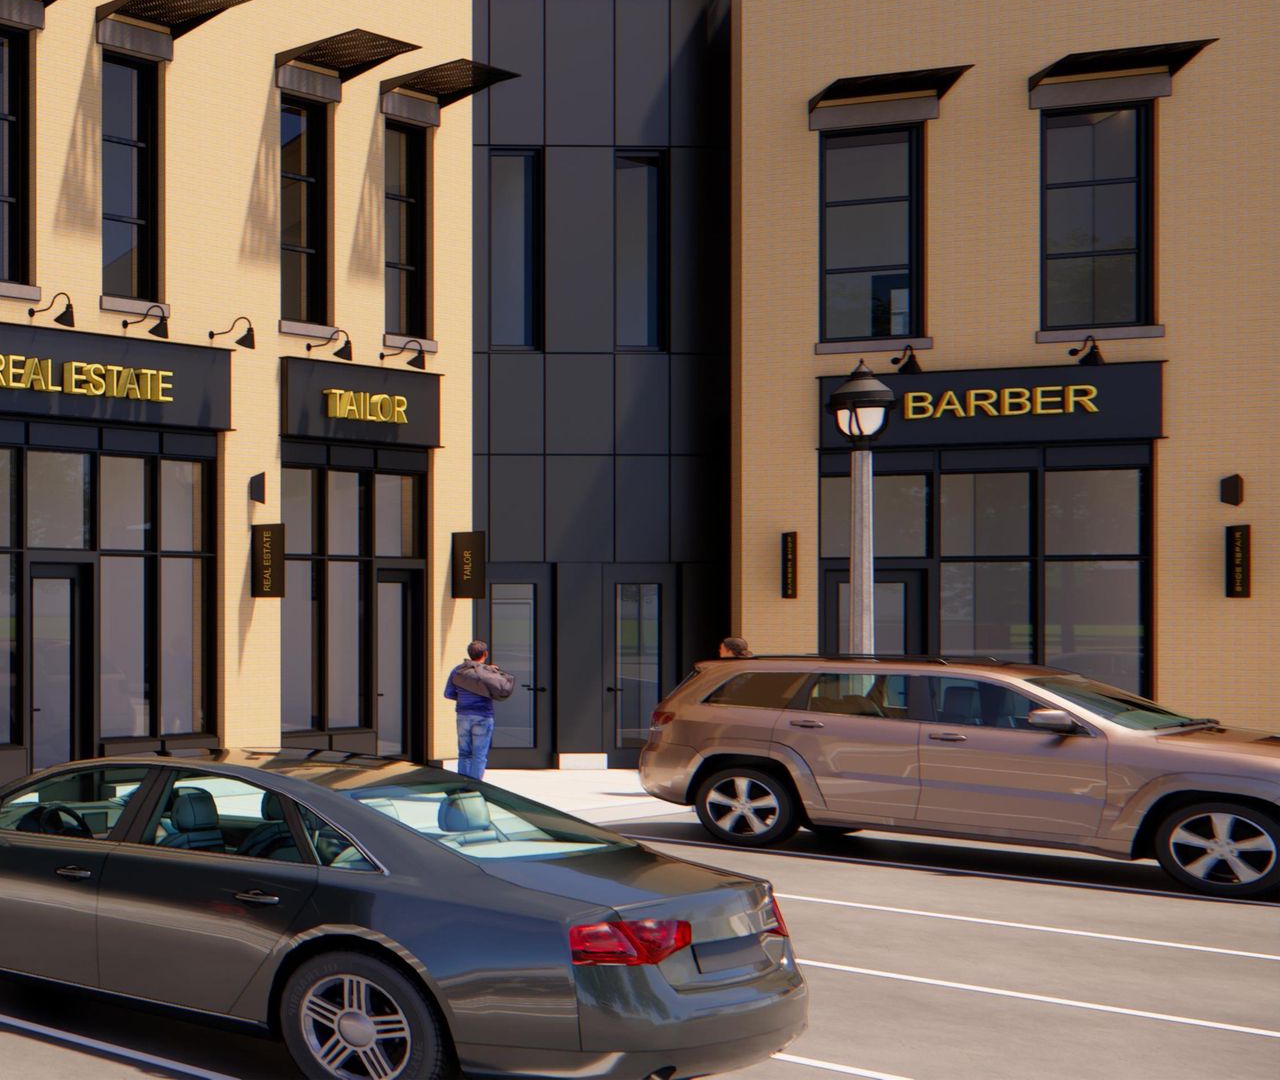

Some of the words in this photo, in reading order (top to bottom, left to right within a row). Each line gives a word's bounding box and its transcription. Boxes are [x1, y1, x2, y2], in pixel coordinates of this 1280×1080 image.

[63, 361, 174, 403] ESTATE
[323, 388, 408, 424] TAILOR
[903, 384, 1100, 419] BARBER
[263, 530, 272, 566] ESTATE
[463, 550, 472, 581] TAILOR
[263, 567, 272, 592] REAL
